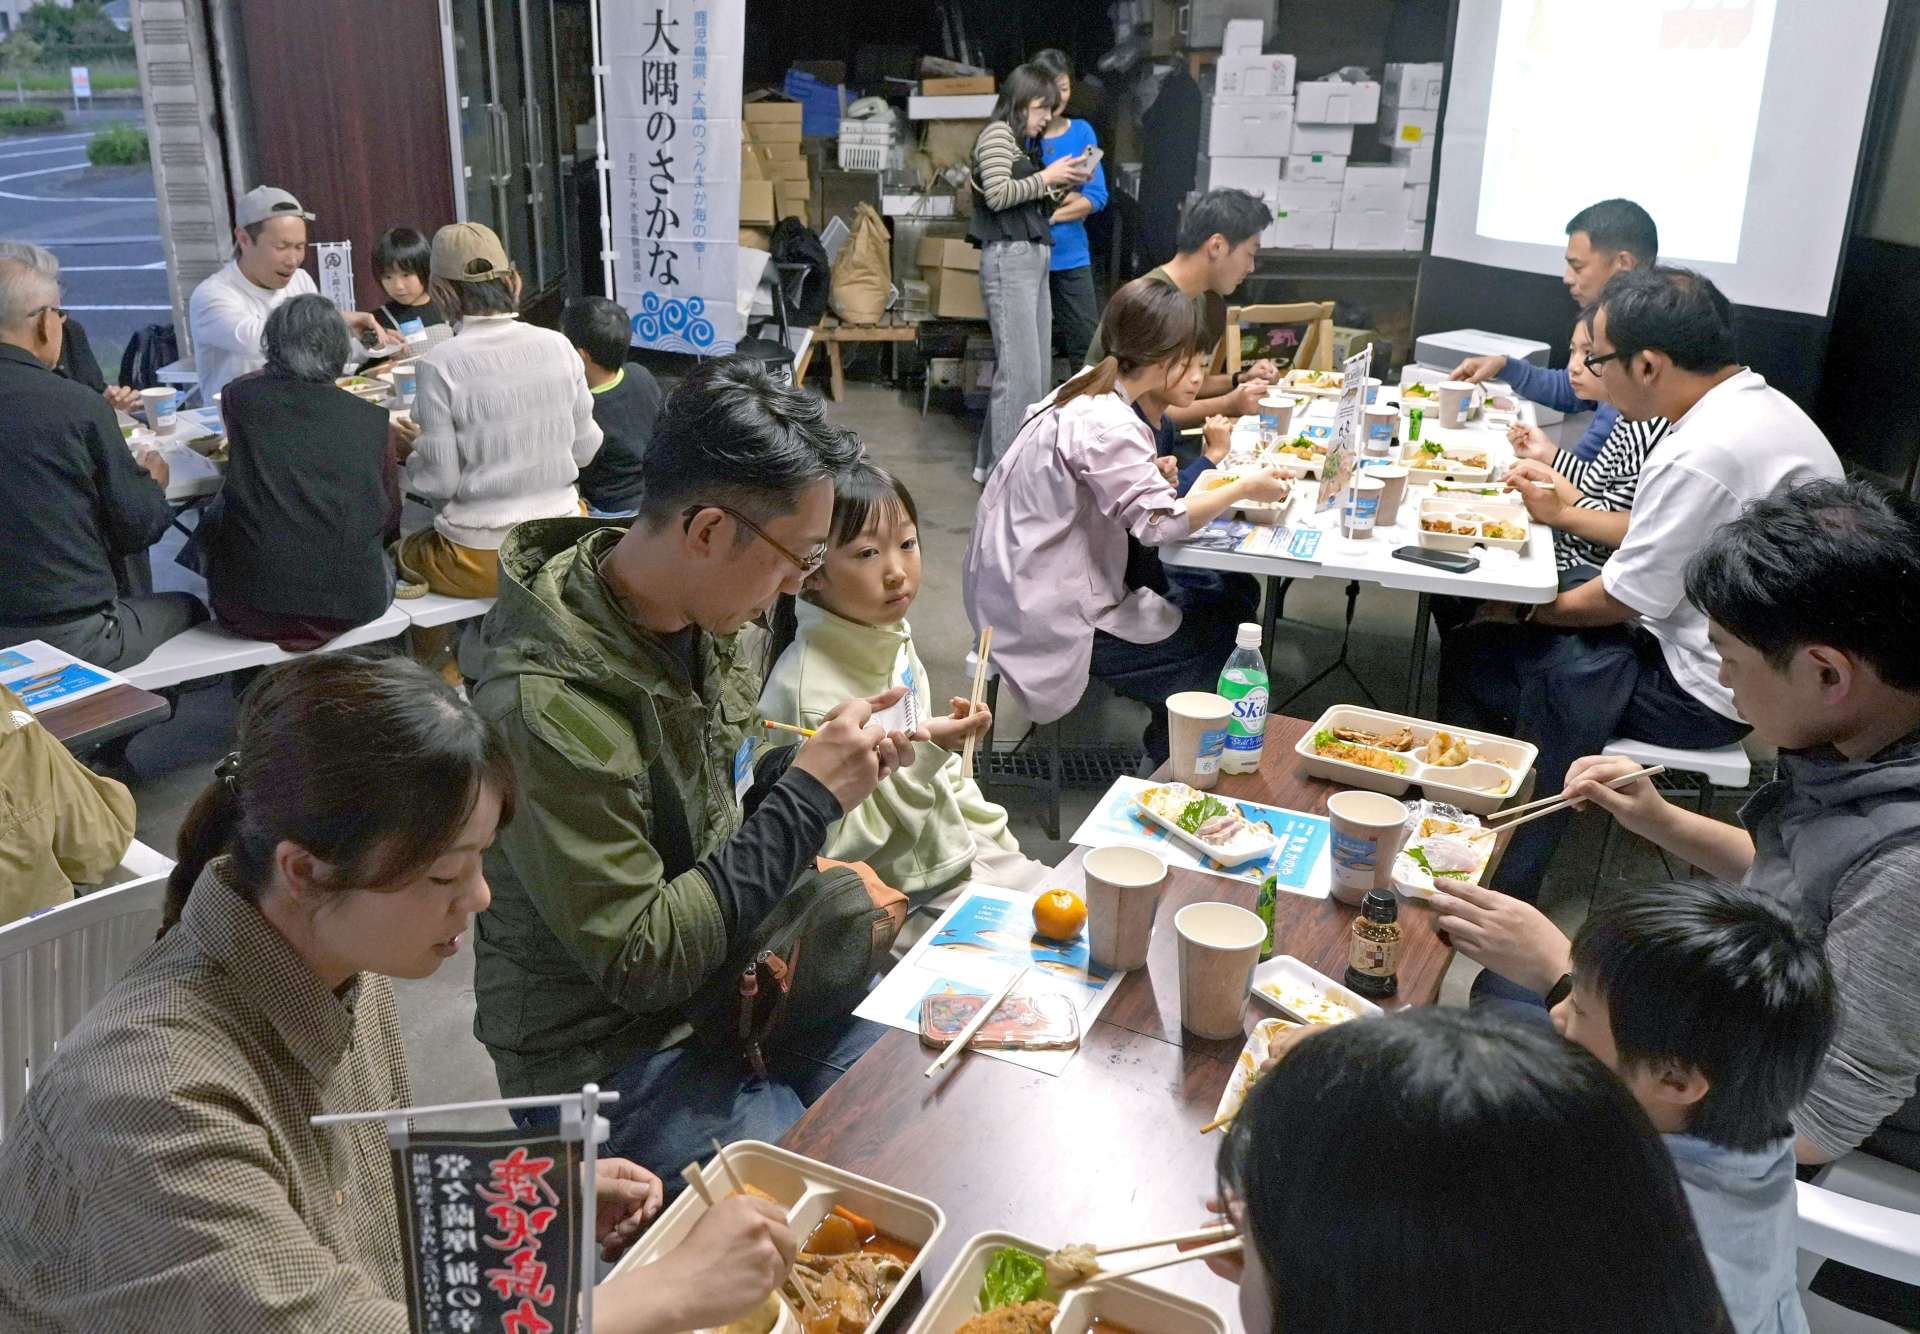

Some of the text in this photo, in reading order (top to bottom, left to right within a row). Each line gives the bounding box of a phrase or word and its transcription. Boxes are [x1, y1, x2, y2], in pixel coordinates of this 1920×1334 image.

[642, 8, 680, 286] 大隅のさかな
